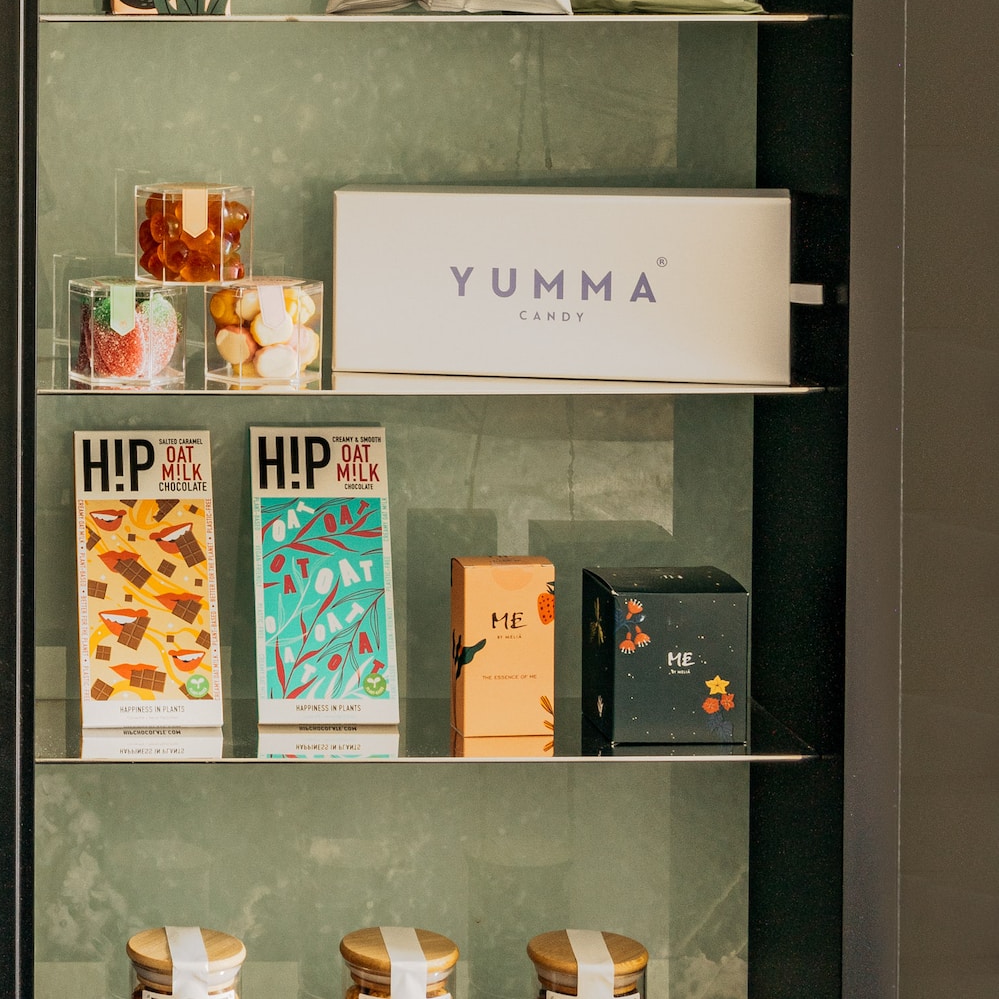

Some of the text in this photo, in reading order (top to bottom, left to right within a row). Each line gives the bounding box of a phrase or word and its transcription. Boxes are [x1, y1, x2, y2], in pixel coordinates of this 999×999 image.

[450, 266, 656, 302] YUMMA
[519, 311, 584, 322] CANDY
[166, 446, 194, 463] OAT
[258, 436, 331, 489] H!P
[341, 444, 371, 463] OAT
[82, 438, 155, 492] H!P
[162, 464, 202, 481] M!LK
[337, 463, 380, 482] M!LK
[159, 482, 207, 492] CHOCOLATE
[272, 501, 315, 542] OAT
[324, 500, 370, 533] OAT
[314, 558, 373, 594] OAT
[314, 602, 365, 642] OAT
[492, 612, 527, 629] ME
[668, 652, 695, 667] ME
